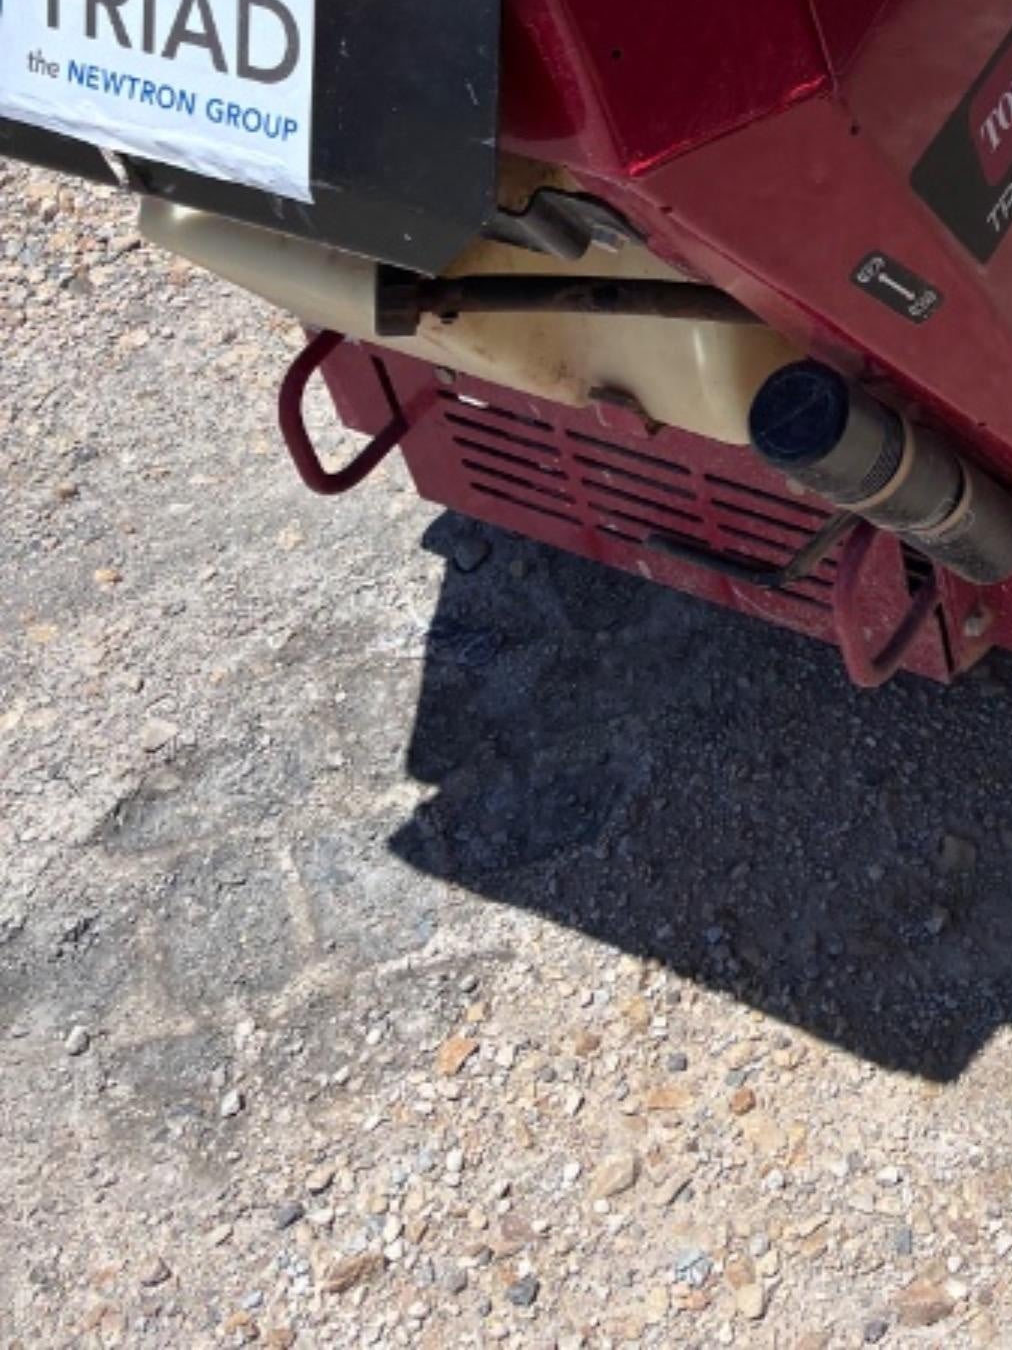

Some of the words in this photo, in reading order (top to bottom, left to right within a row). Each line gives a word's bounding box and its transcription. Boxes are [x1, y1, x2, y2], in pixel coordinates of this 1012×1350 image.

[27, 50, 60, 78] the
[67, 59, 197, 115] NEWTRON
[205, 98, 299, 141] GROUP
